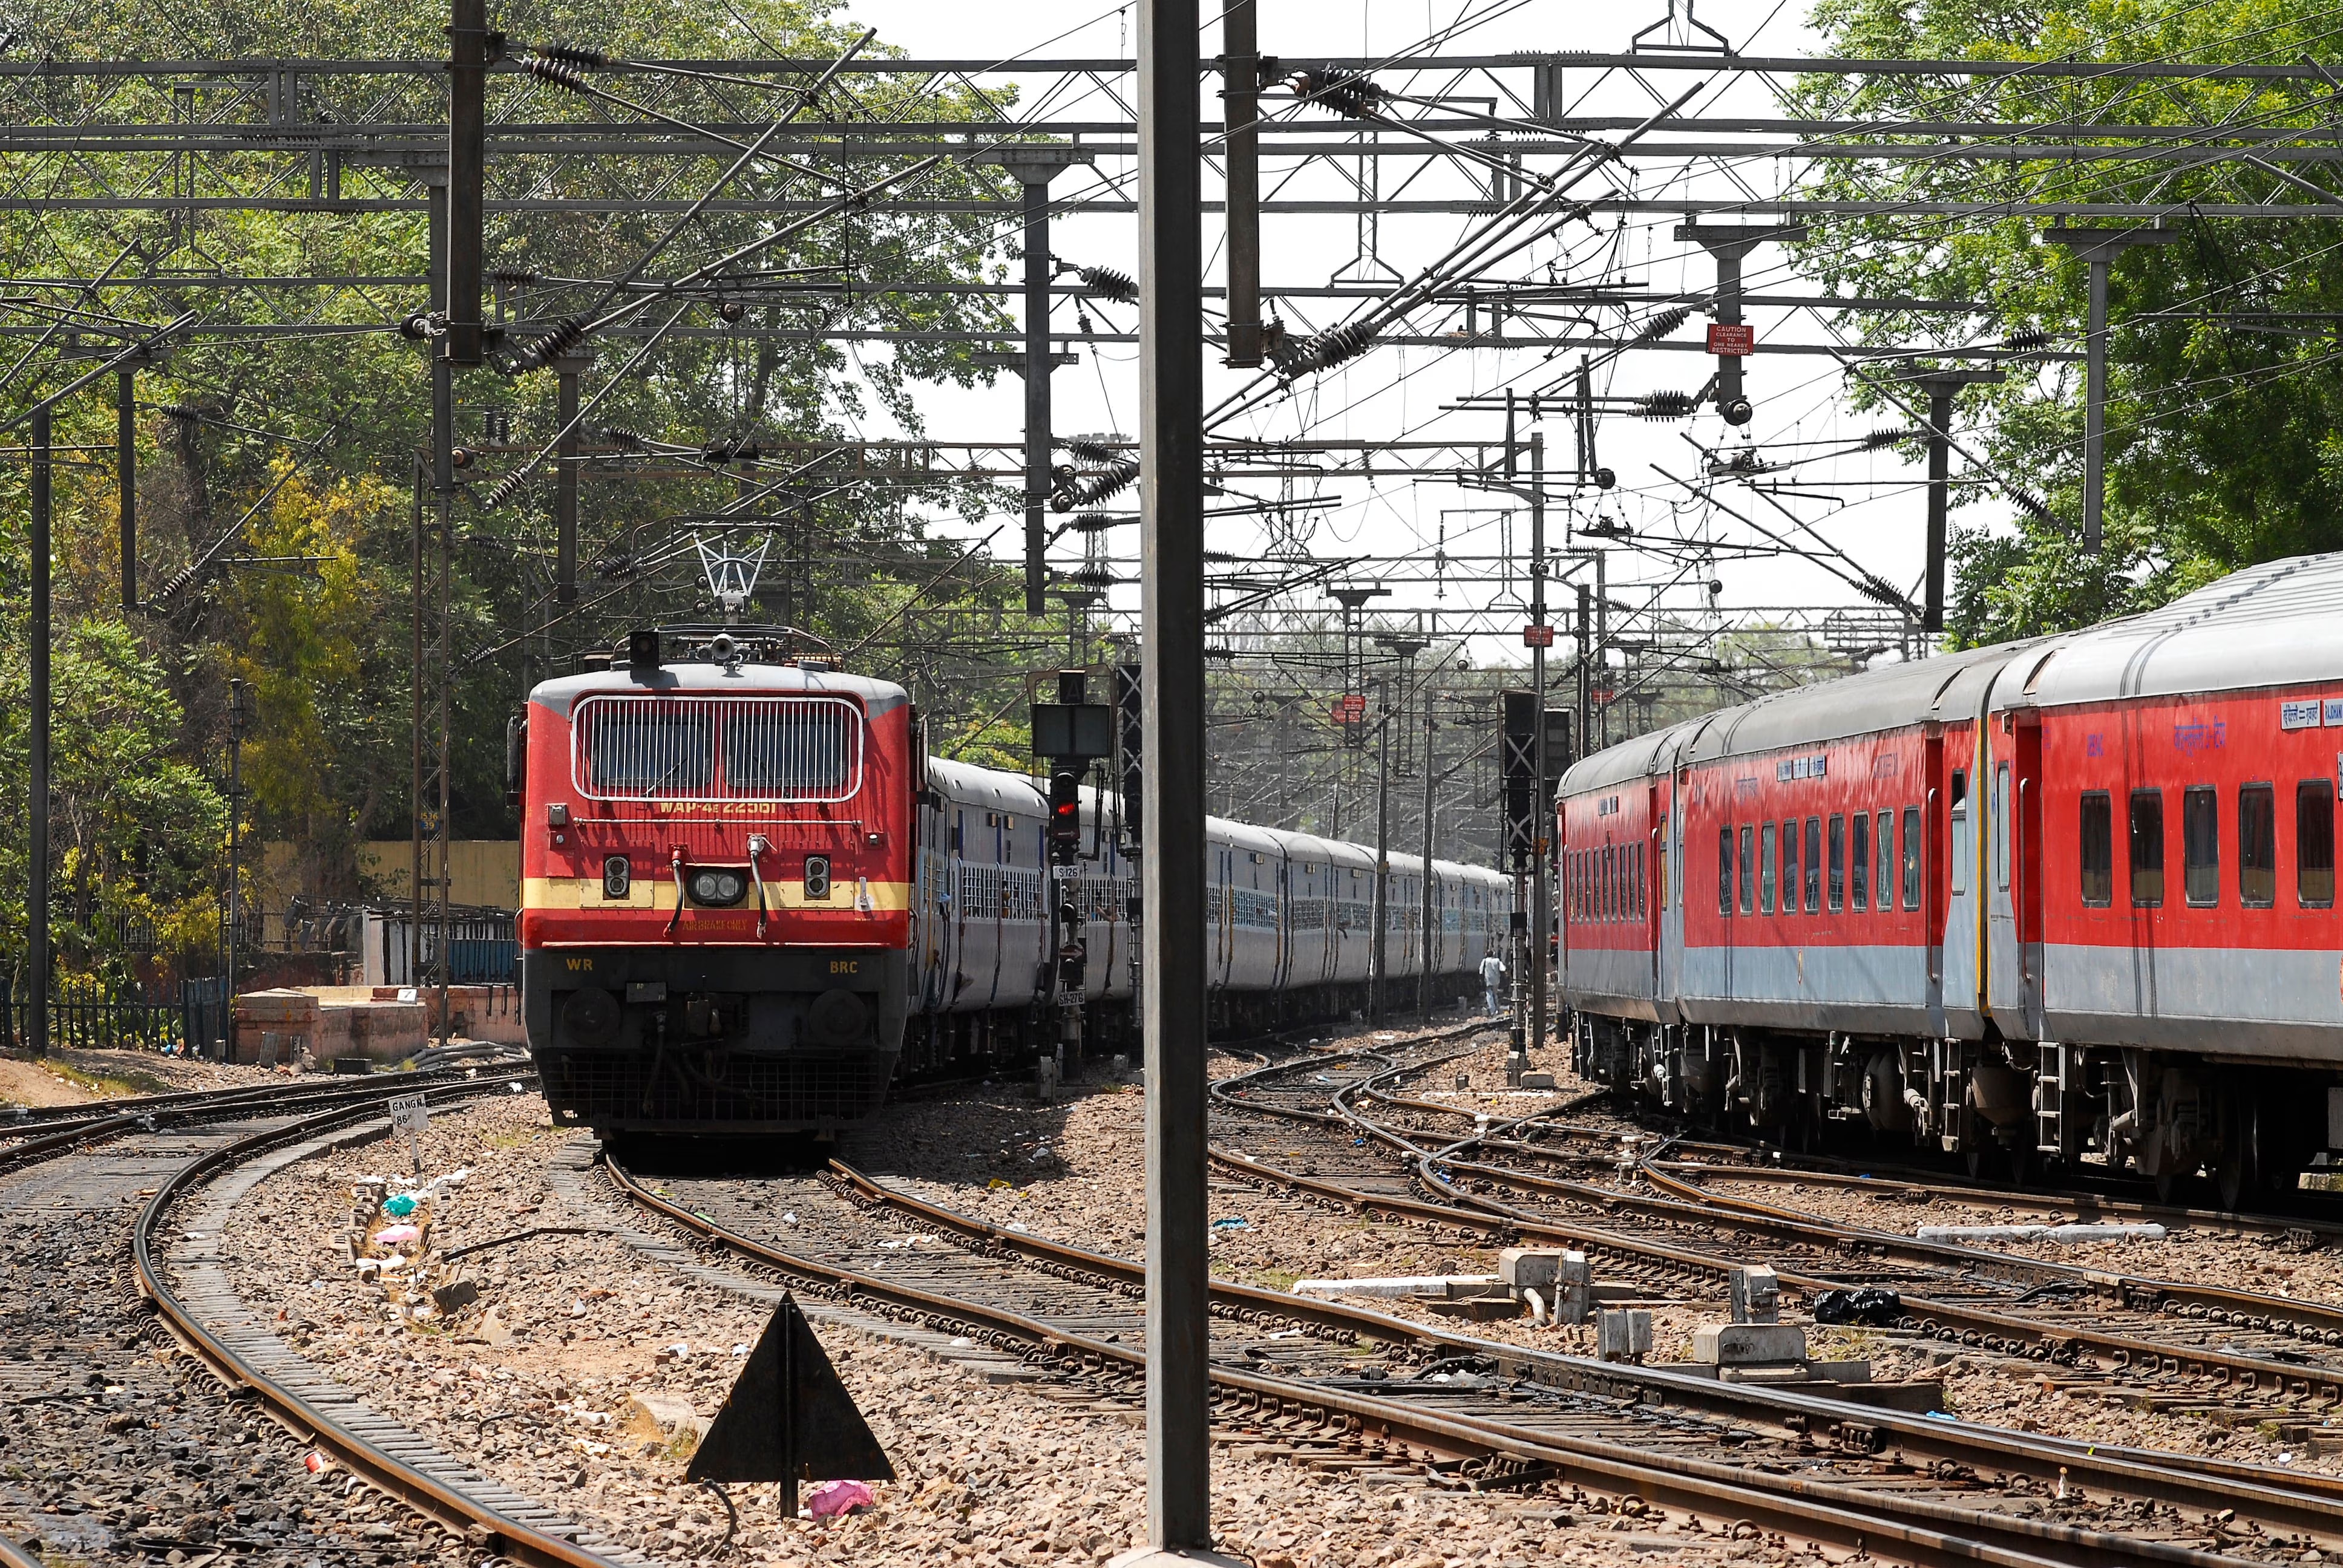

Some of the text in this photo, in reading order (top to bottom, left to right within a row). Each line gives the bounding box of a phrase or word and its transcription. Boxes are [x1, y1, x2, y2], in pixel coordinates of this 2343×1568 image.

[698, 920, 726, 930] BRAKE
[726, 919, 747, 930] ONLY
[566, 958, 593, 971] WR
[830, 961, 857, 973] BRC
